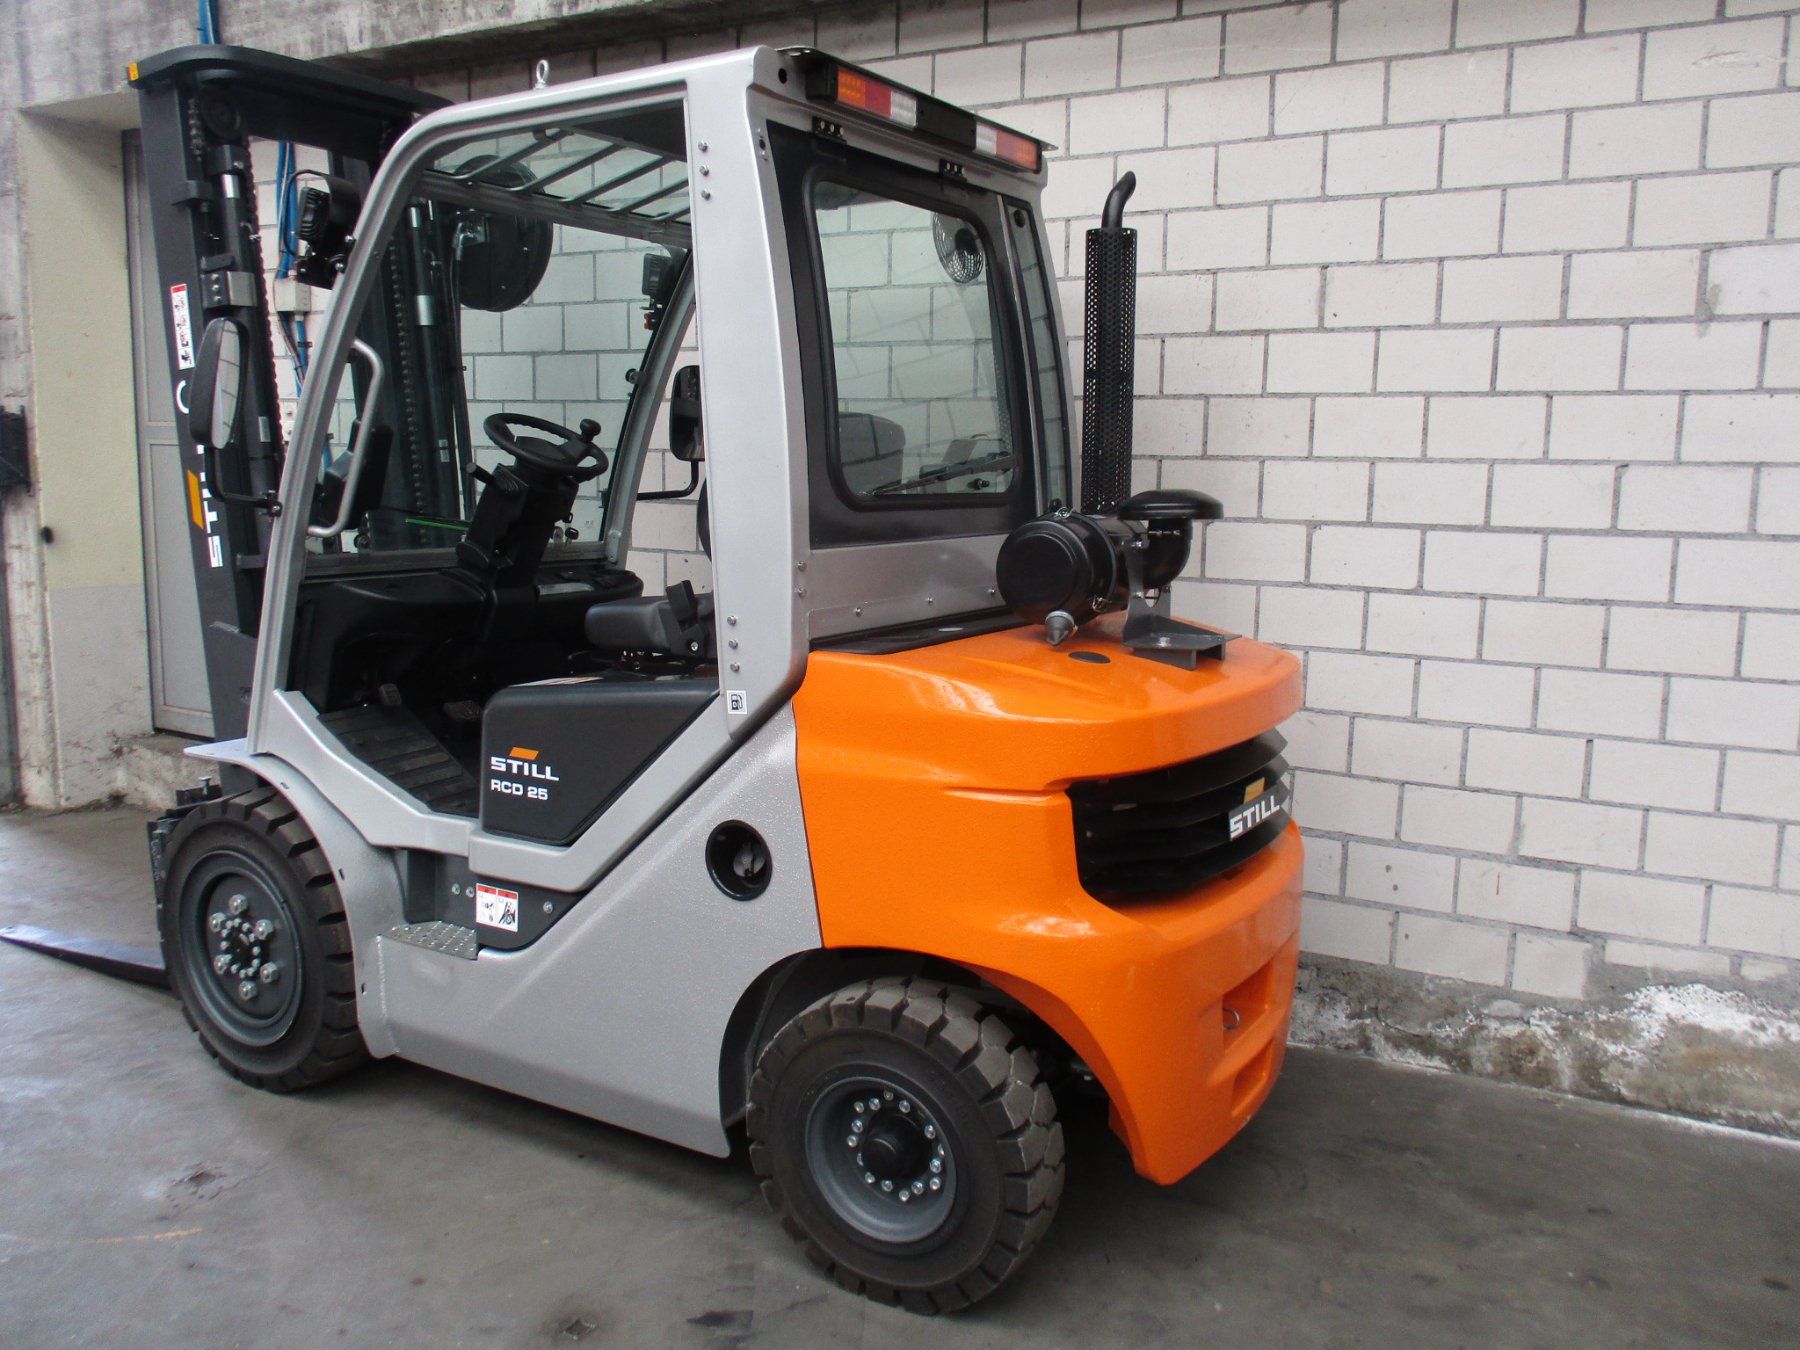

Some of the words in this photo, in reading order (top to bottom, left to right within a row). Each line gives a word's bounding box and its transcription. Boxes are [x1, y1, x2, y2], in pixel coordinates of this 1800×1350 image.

[196, 444, 224, 568] STI
[490, 756, 560, 781] STILL
[490, 779, 524, 796] RCD
[527, 786, 549, 801] 25
[1230, 795, 1281, 840] STILL
